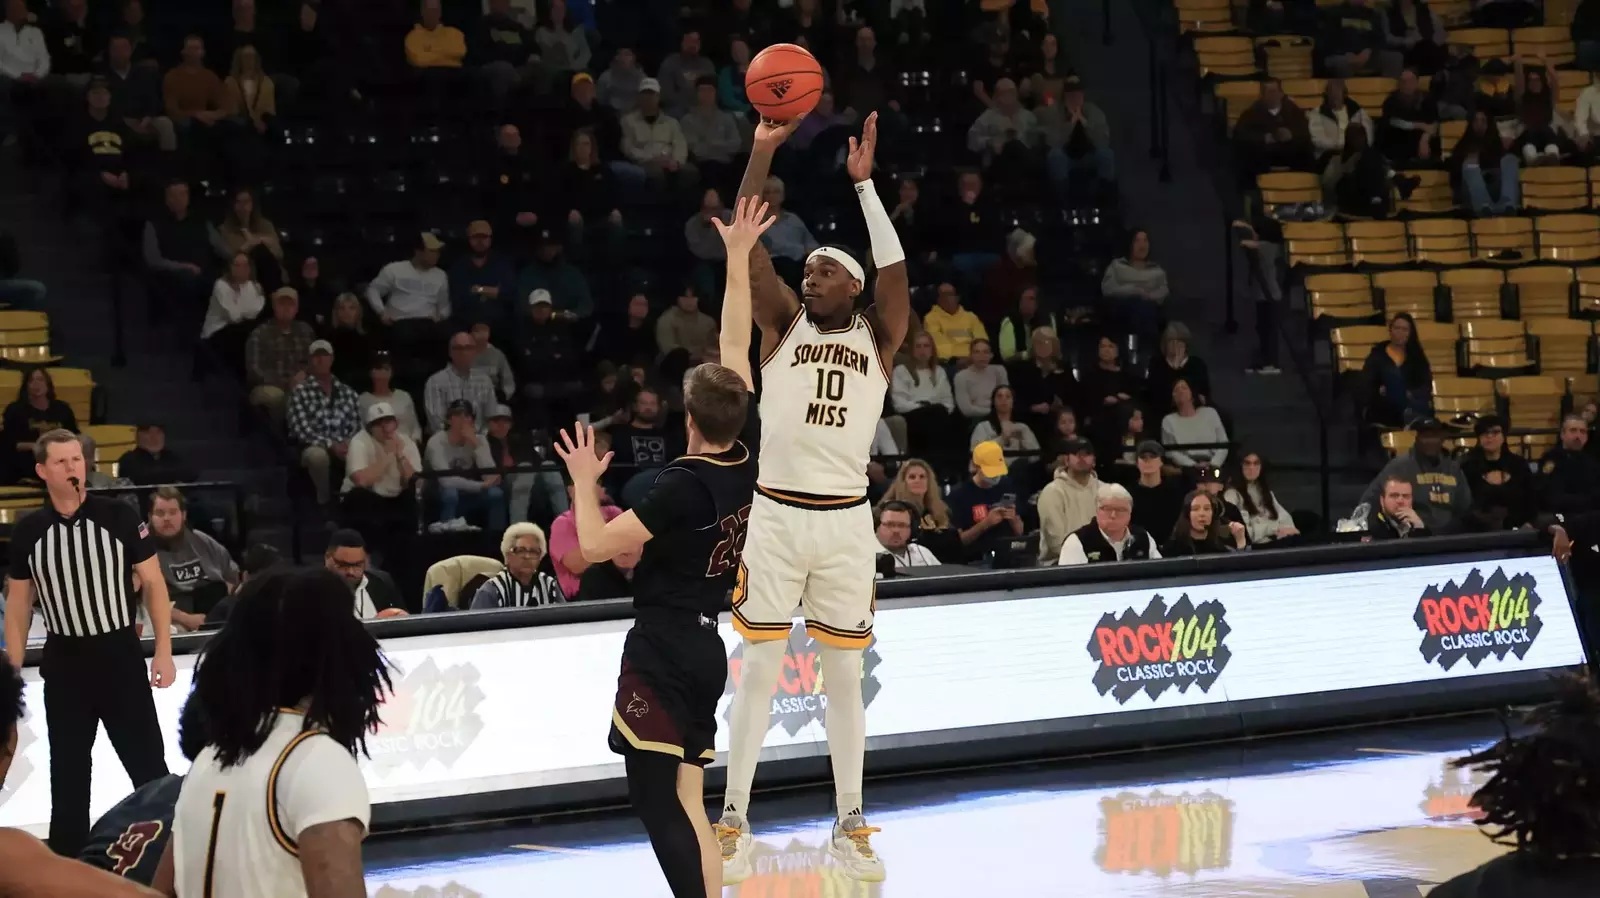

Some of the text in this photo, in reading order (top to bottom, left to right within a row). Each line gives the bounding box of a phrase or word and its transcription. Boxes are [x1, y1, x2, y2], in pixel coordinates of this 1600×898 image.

[790, 343, 869, 377] SOUTHERN
[816, 368, 845, 401] 10
[805, 402, 848, 427] MISS
[1440, 628, 1531, 651] CLASSIC ROCK
[1116, 659, 1218, 682] CLASSIC ROCK
[769, 695, 817, 715] ASSIC
